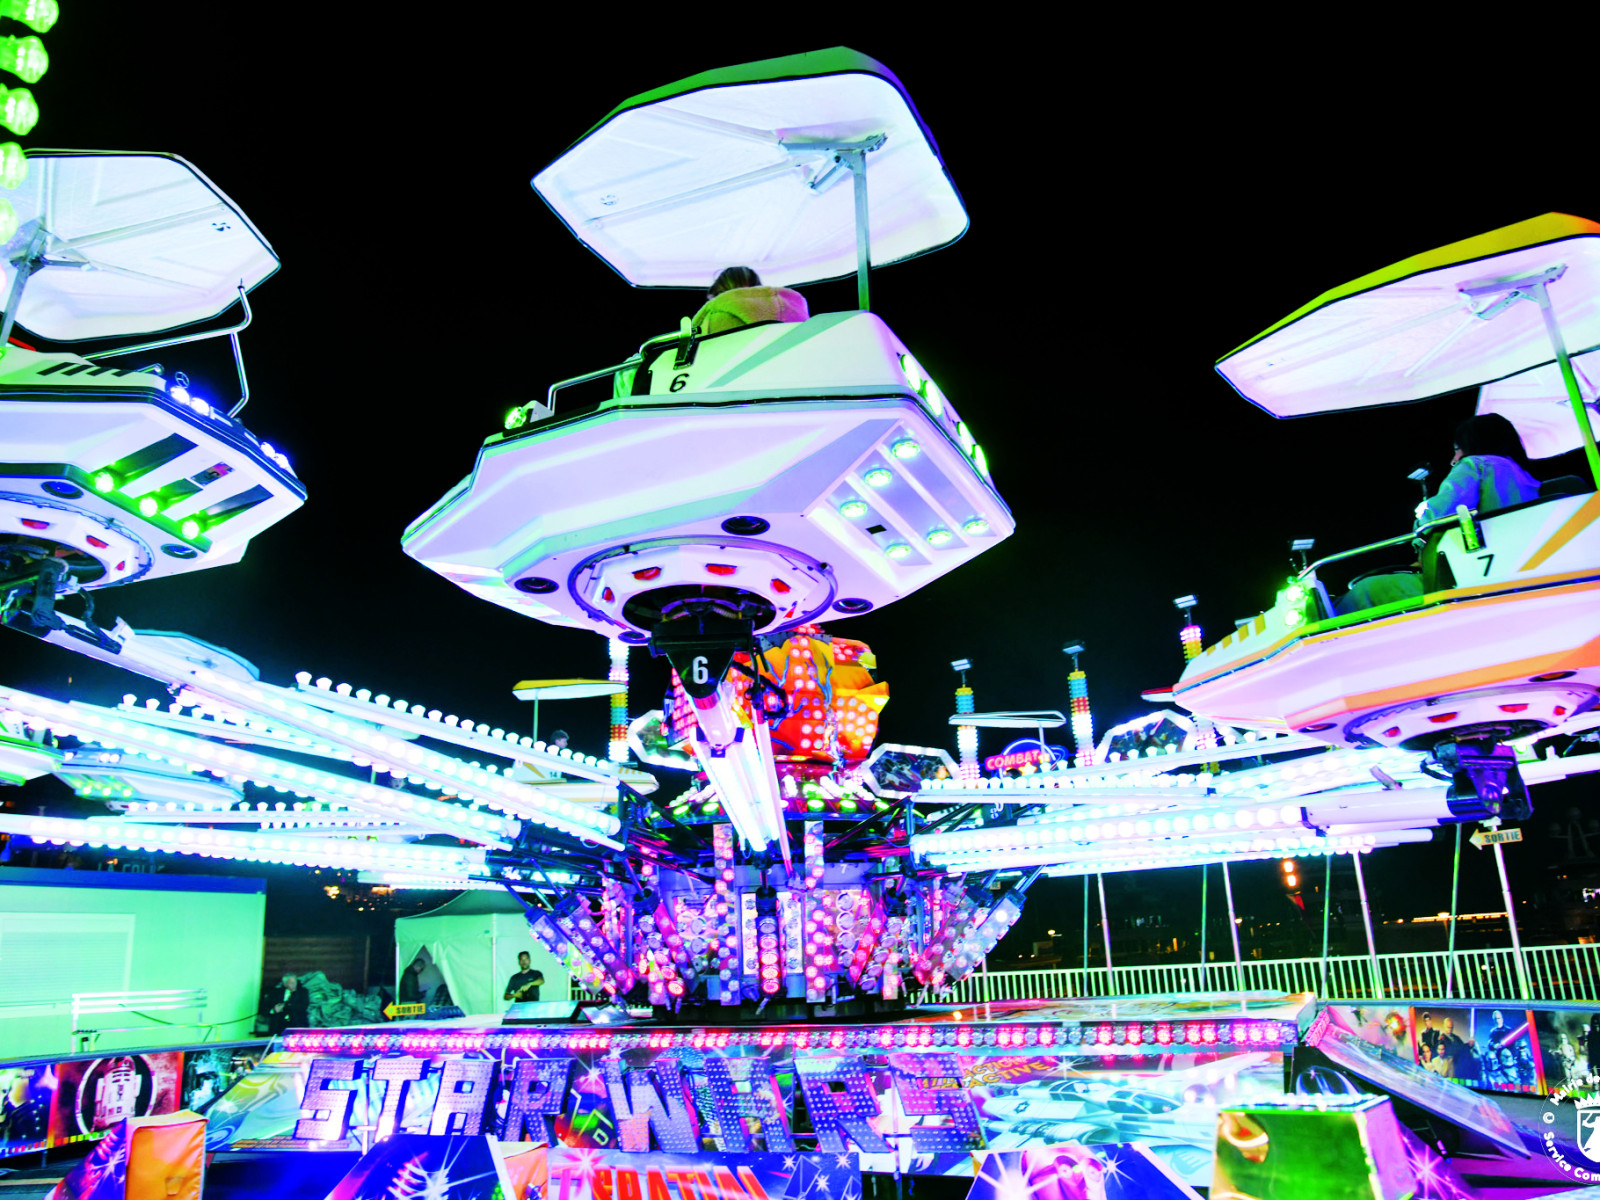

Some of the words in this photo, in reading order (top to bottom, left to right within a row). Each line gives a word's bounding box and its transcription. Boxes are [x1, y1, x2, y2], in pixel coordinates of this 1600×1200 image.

[669, 373, 690, 392] 6
[1477, 554, 1494, 577] 7
[692, 655, 709, 685] 6
[987, 750, 1040, 769] COMBAT
[1484, 831, 1520, 843] SORTIE
[292, 1058, 576, 1147] STAR
[600, 1051, 989, 1154] WARS
